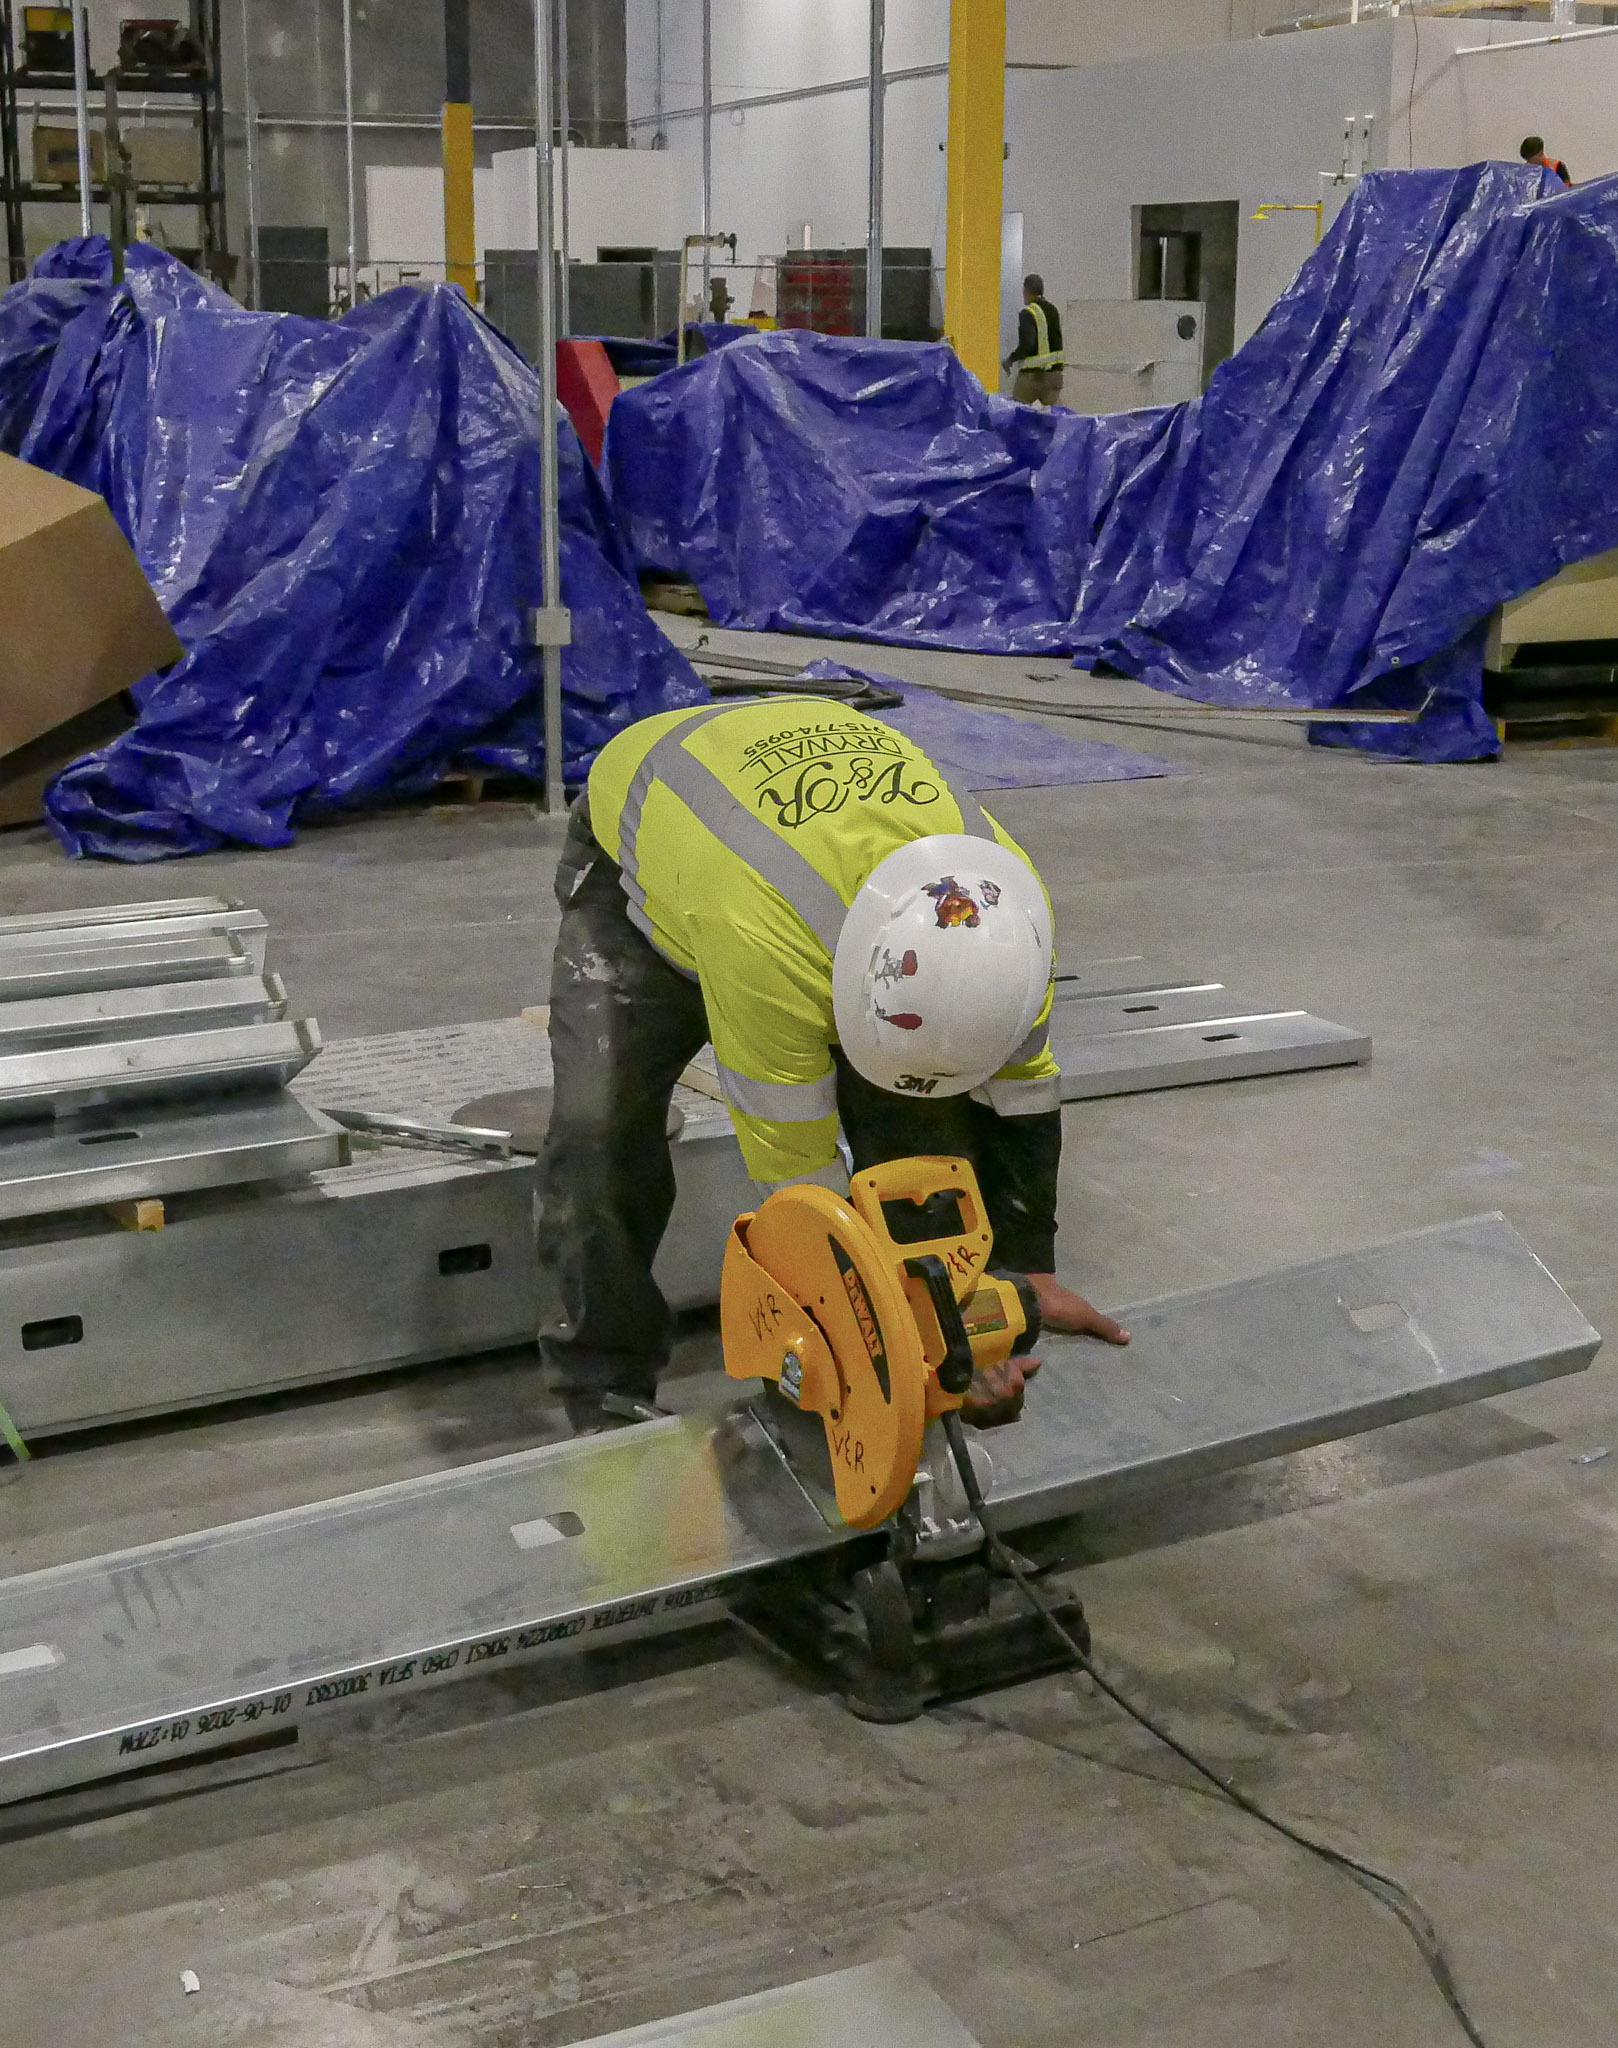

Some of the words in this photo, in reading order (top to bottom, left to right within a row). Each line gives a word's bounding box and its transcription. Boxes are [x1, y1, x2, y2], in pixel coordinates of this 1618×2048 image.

[743, 722, 886, 757] 915-774-0955
[750, 735, 904, 774] DRYWALL
[894, 1074, 939, 1095] 3M
[196, 1693, 292, 1736] 01-06-2026
